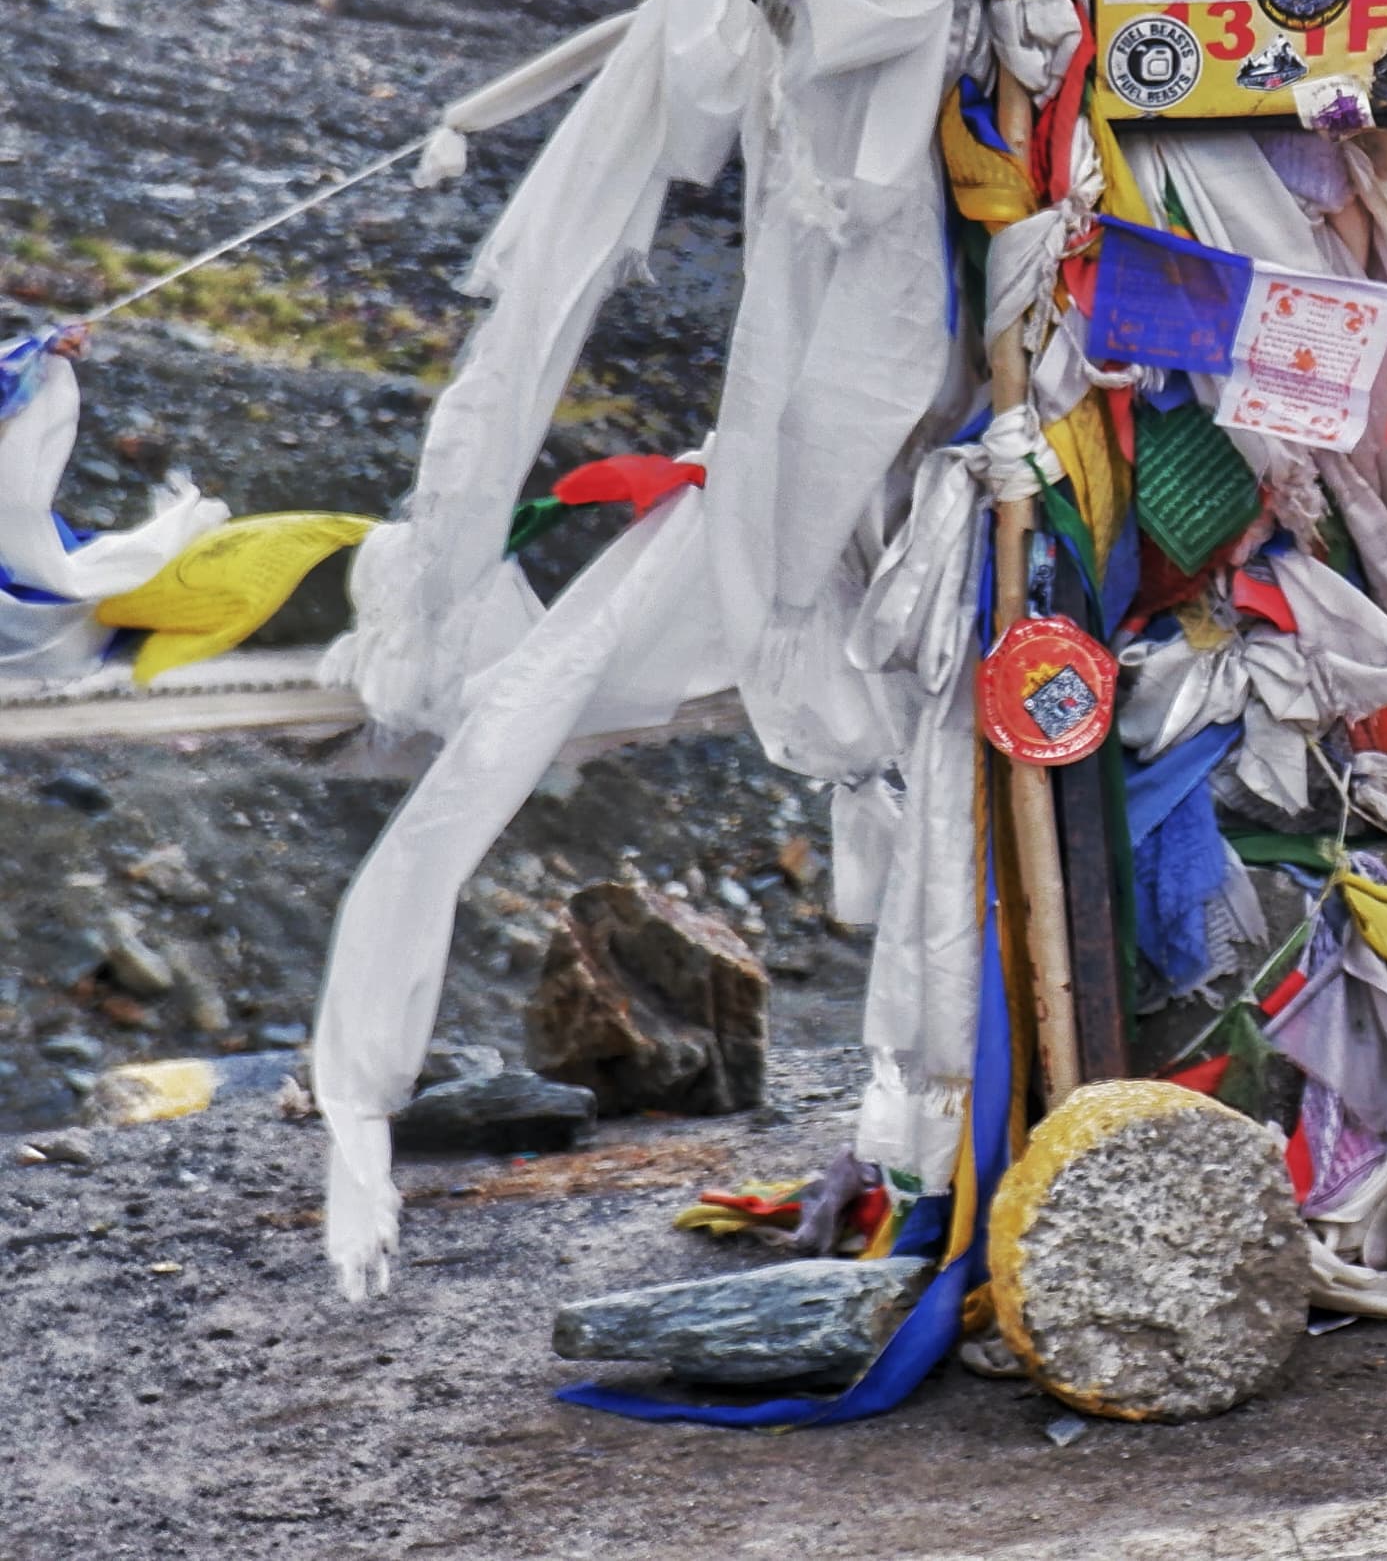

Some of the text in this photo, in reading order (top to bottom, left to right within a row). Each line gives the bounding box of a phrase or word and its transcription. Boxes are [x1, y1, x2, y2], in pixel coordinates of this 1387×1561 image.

[1116, 23, 1195, 59] FUEL BEASTS
[1116, 73, 1192, 104] FUEL BEASTS
